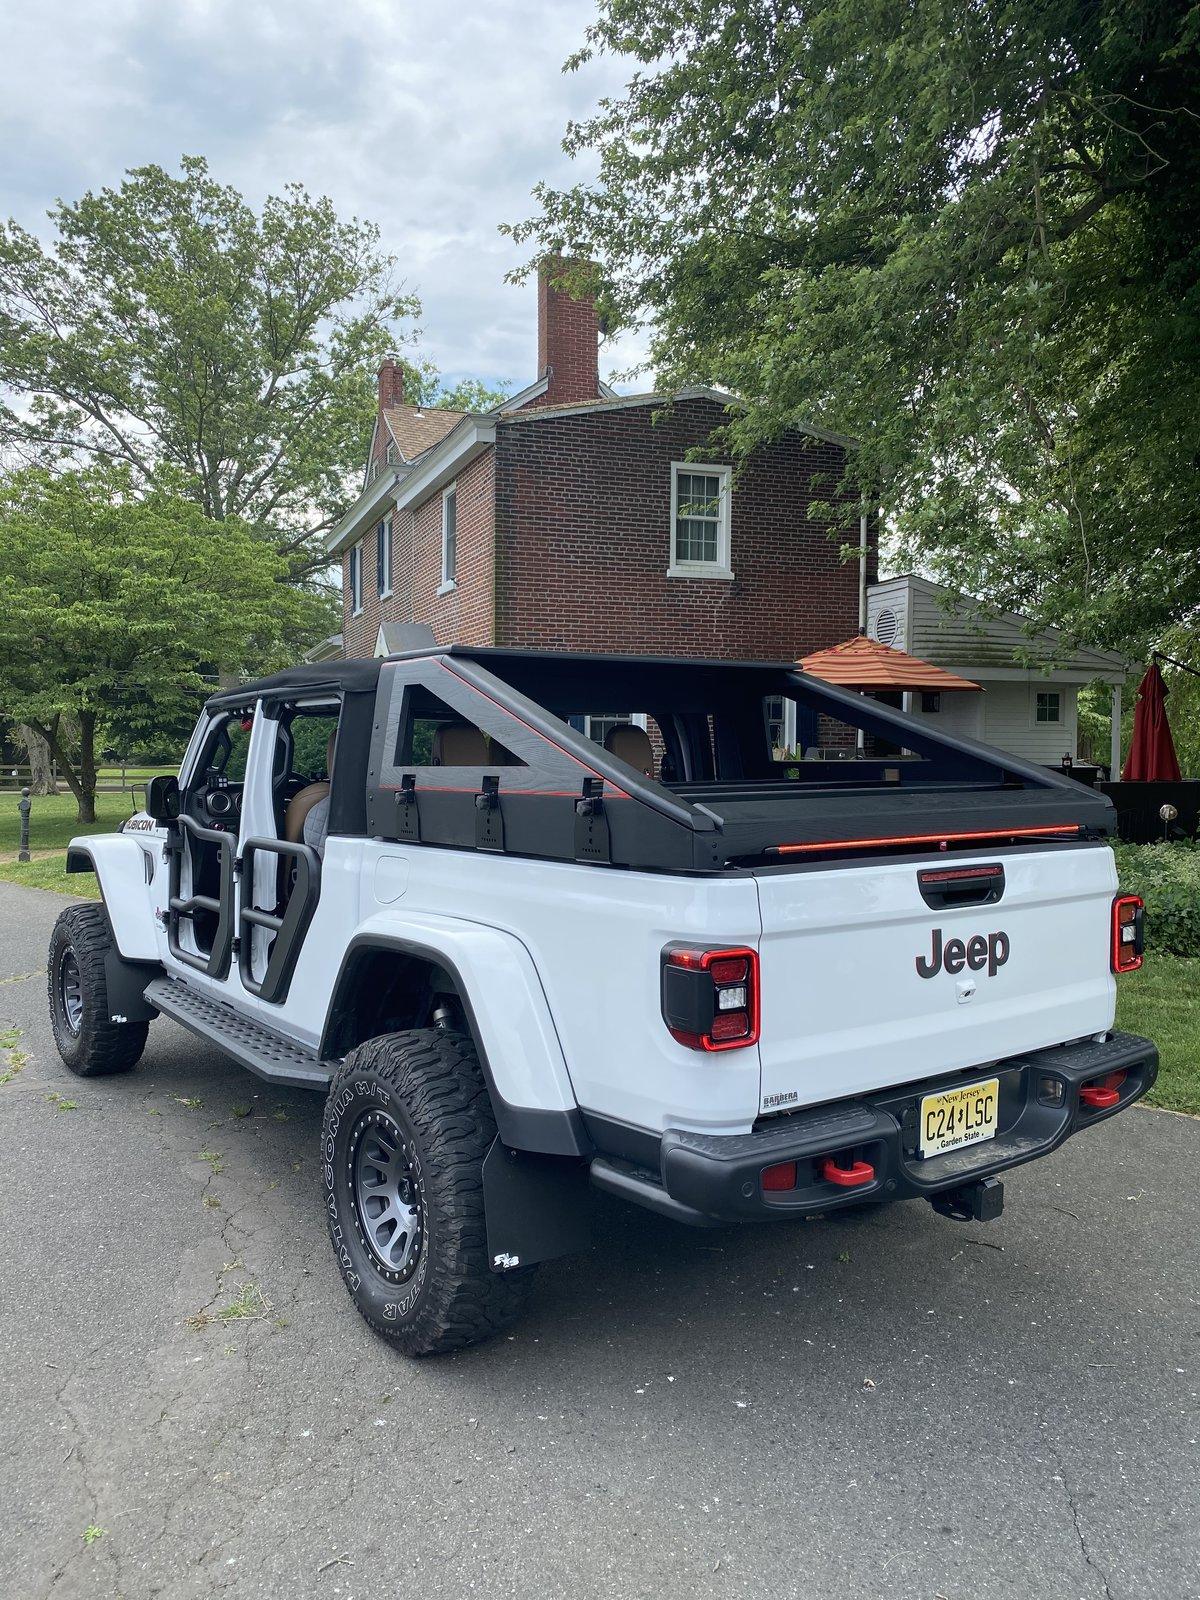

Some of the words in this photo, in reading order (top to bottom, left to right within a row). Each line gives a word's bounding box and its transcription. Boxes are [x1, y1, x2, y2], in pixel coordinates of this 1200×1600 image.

[915, 928, 1010, 979] Jeep
[763, 1091, 798, 1105] BARBERA
[941, 1094, 959, 1106] New
[959, 1089, 981, 1102] Jersey
[941, 1136, 963, 1149] Garden
[964, 1130, 980, 1142] State
[325, 1088, 361, 1291] PATAGONIA
